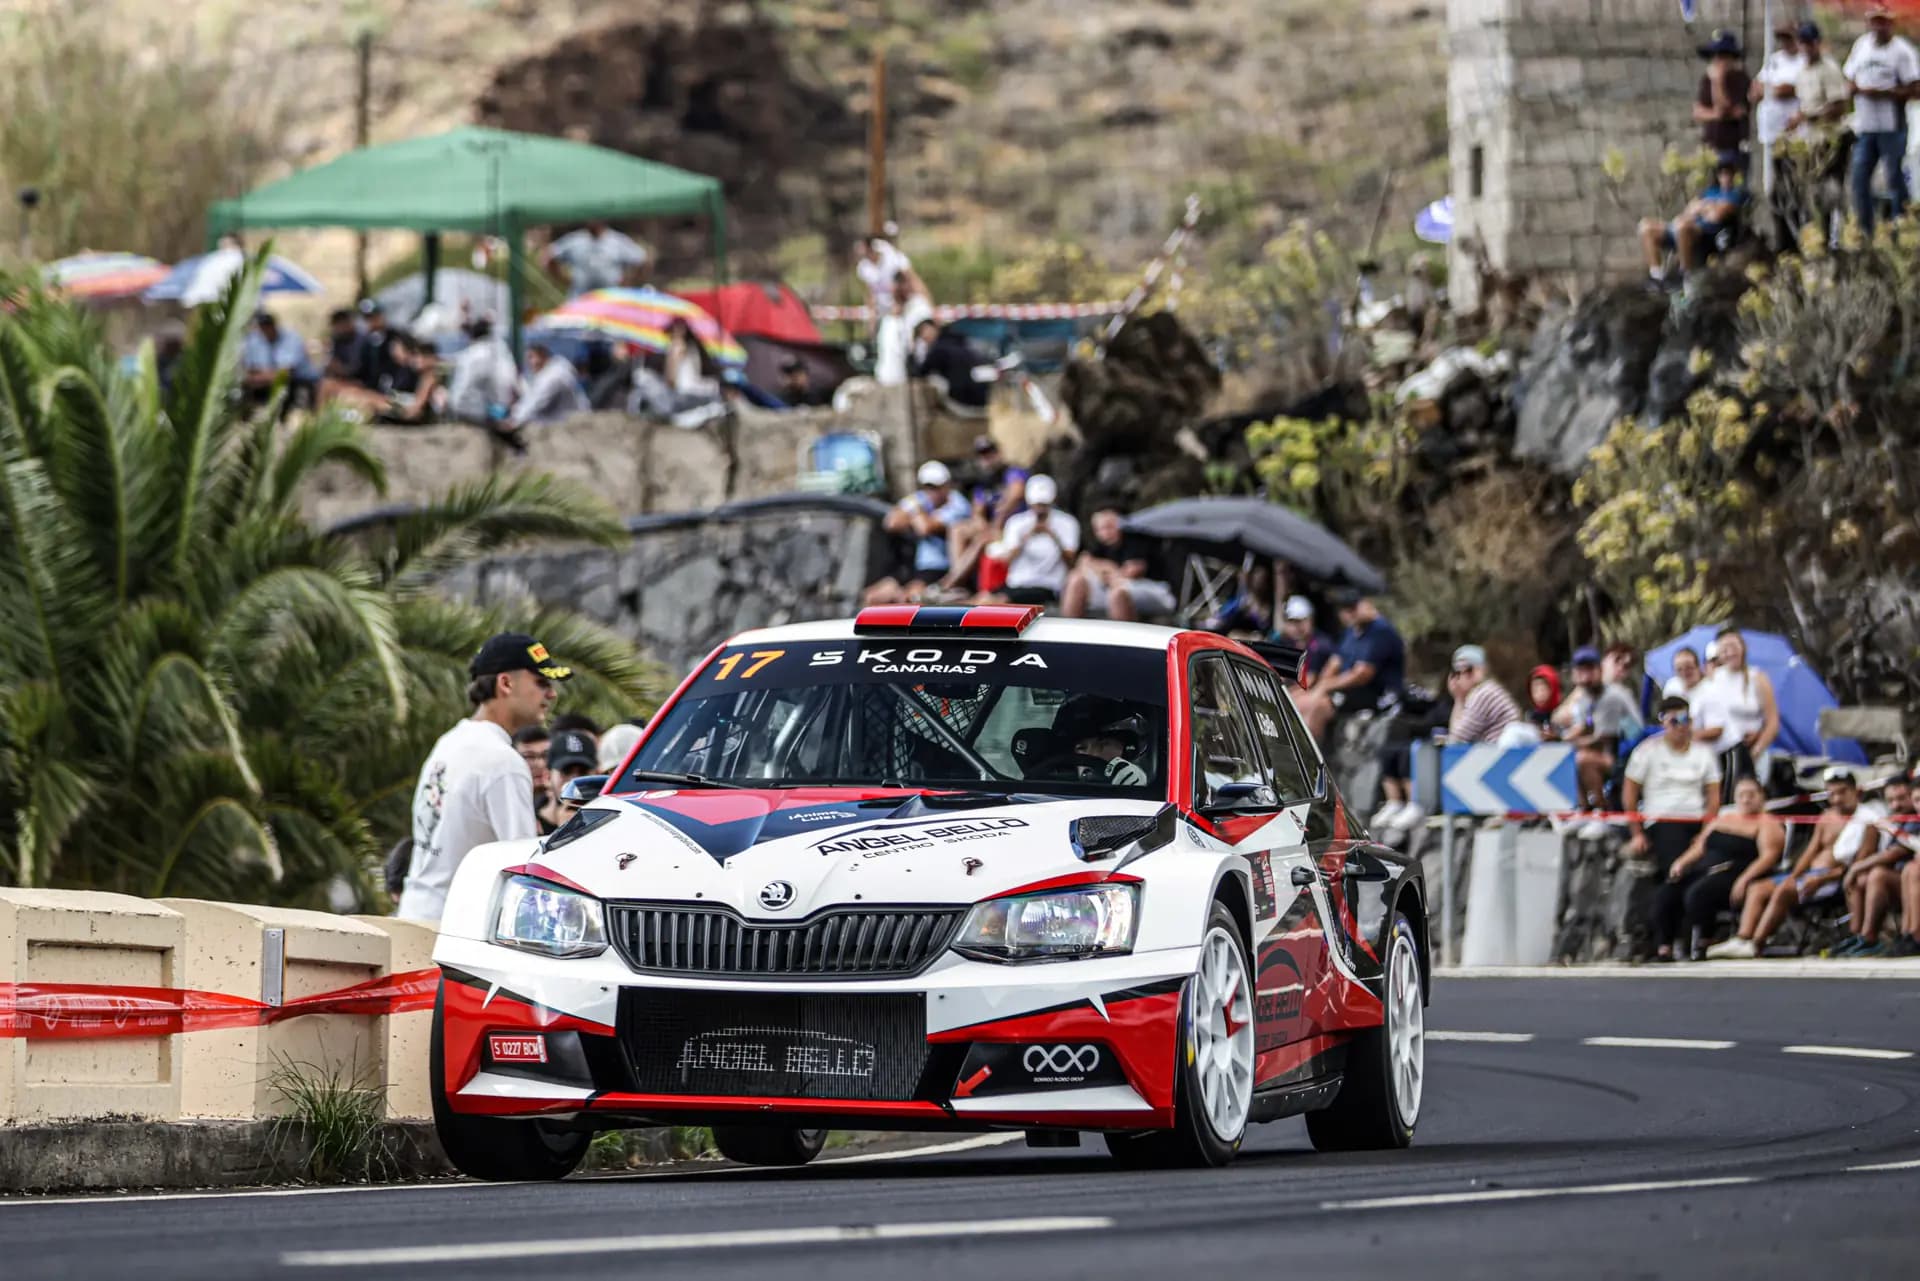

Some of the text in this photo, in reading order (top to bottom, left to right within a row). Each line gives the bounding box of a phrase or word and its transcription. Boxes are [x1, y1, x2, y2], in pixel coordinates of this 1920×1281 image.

[714, 650, 786, 681] 17
[871, 664, 977, 674] CANARIAS
[816, 818, 1030, 856] ANGEL BELLO
[862, 831, 1012, 859] CENTRO SKODA
[494, 1042, 502, 1055] S
[502, 1042, 521, 1056] 0227
[676, 1043, 775, 1072] ANGEL
